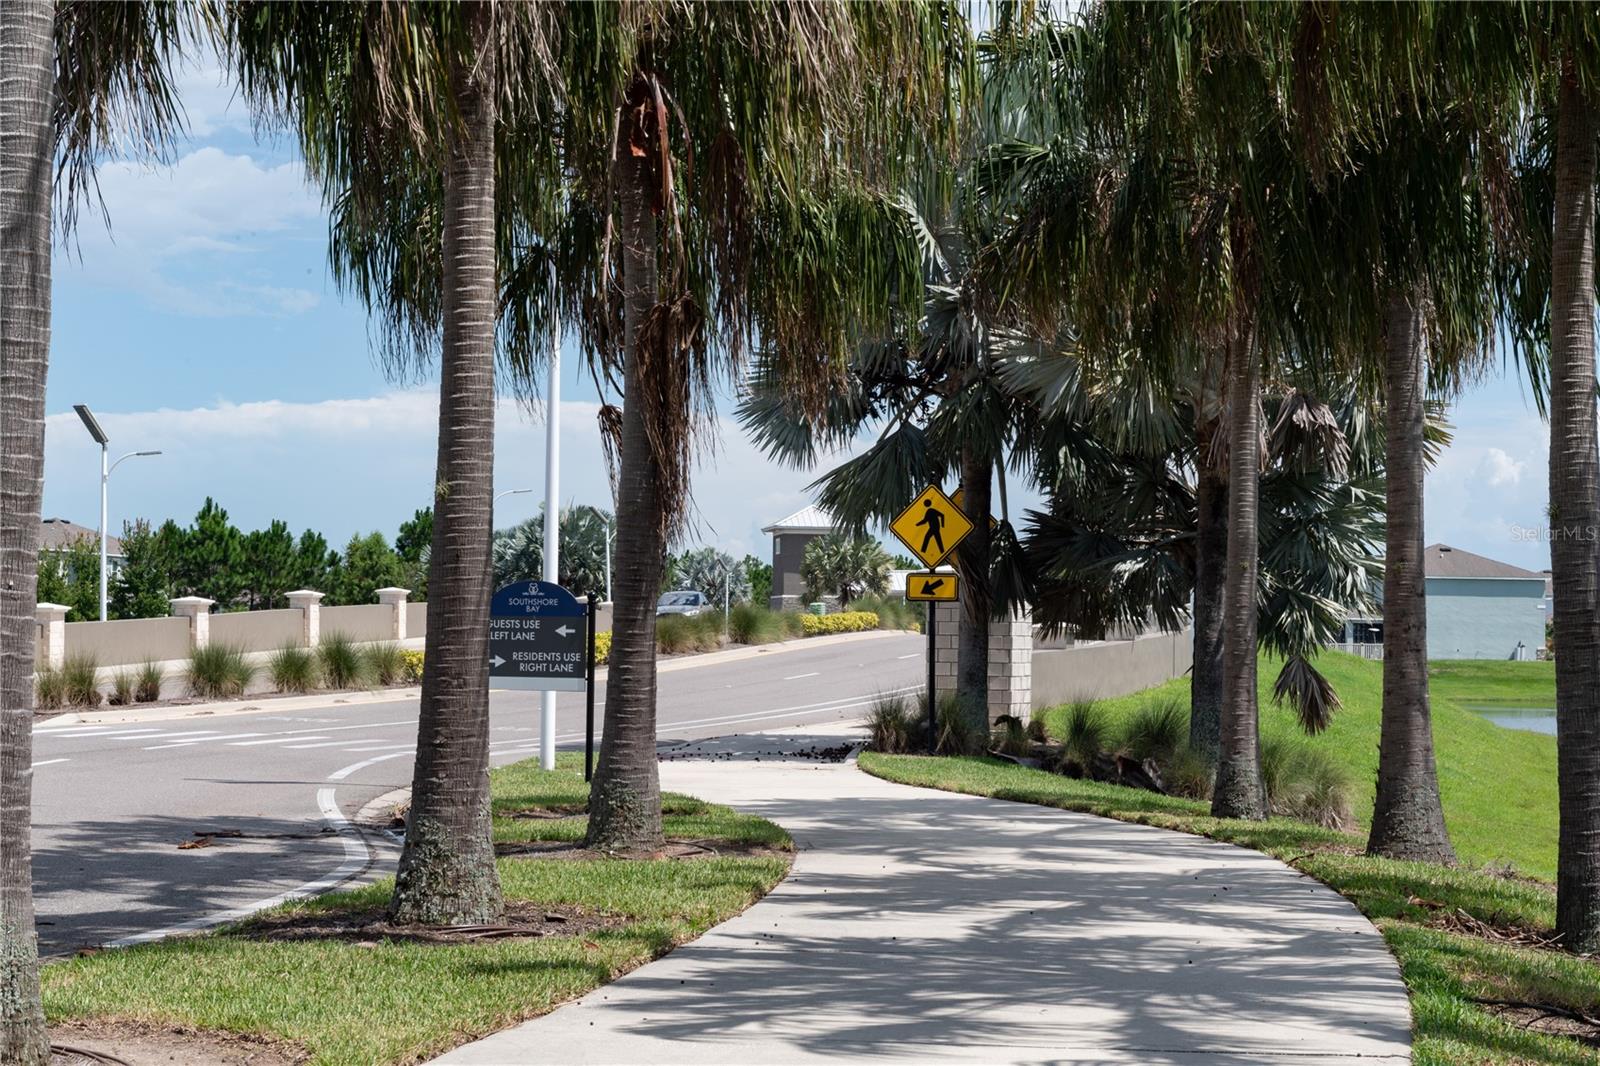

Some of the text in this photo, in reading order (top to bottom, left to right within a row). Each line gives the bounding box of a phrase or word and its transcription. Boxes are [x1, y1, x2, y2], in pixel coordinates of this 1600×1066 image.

[508, 598, 559, 606] SOUTHSHORE
[525, 605, 540, 613] BAY
[522, 619, 541, 629] USE
[490, 631, 535, 641] LEFT LANE
[512, 651, 581, 662] RESIDENTS USE
[519, 662, 574, 673] RIGHT LANE
